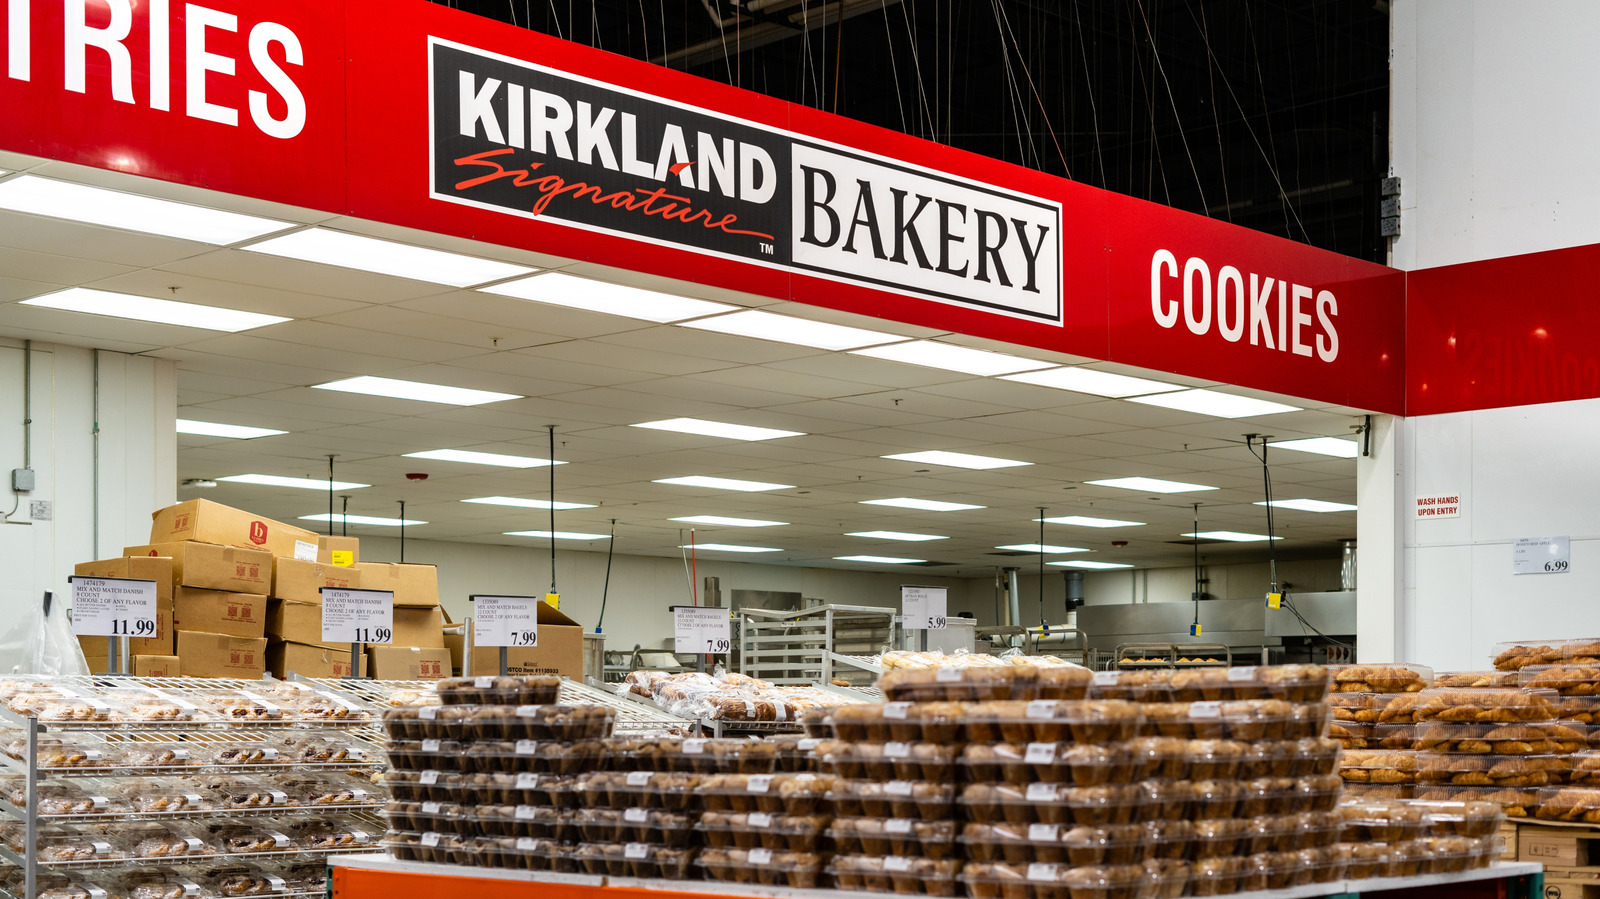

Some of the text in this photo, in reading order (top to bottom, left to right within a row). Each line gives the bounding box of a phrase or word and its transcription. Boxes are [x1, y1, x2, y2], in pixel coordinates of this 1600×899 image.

[459, 70, 777, 204] KIRKLAND
[453, 147, 775, 240] Signature
[800, 164, 1049, 294] BAKERY
[759, 242, 774, 255] TM
[1151, 249, 1339, 363] COOKIES
[1416, 496, 1458, 506] WASH HANDS
[1418, 506, 1458, 516] UPON ENTRY
[1544, 560, 1568, 572] 6.99
[112, 619, 154, 635] 11.99
[928, 617, 946, 628] 5.99
[355, 628, 391, 642] 11.99
[511, 632, 536, 645] 7.99
[707, 640, 730, 652] 7.99
